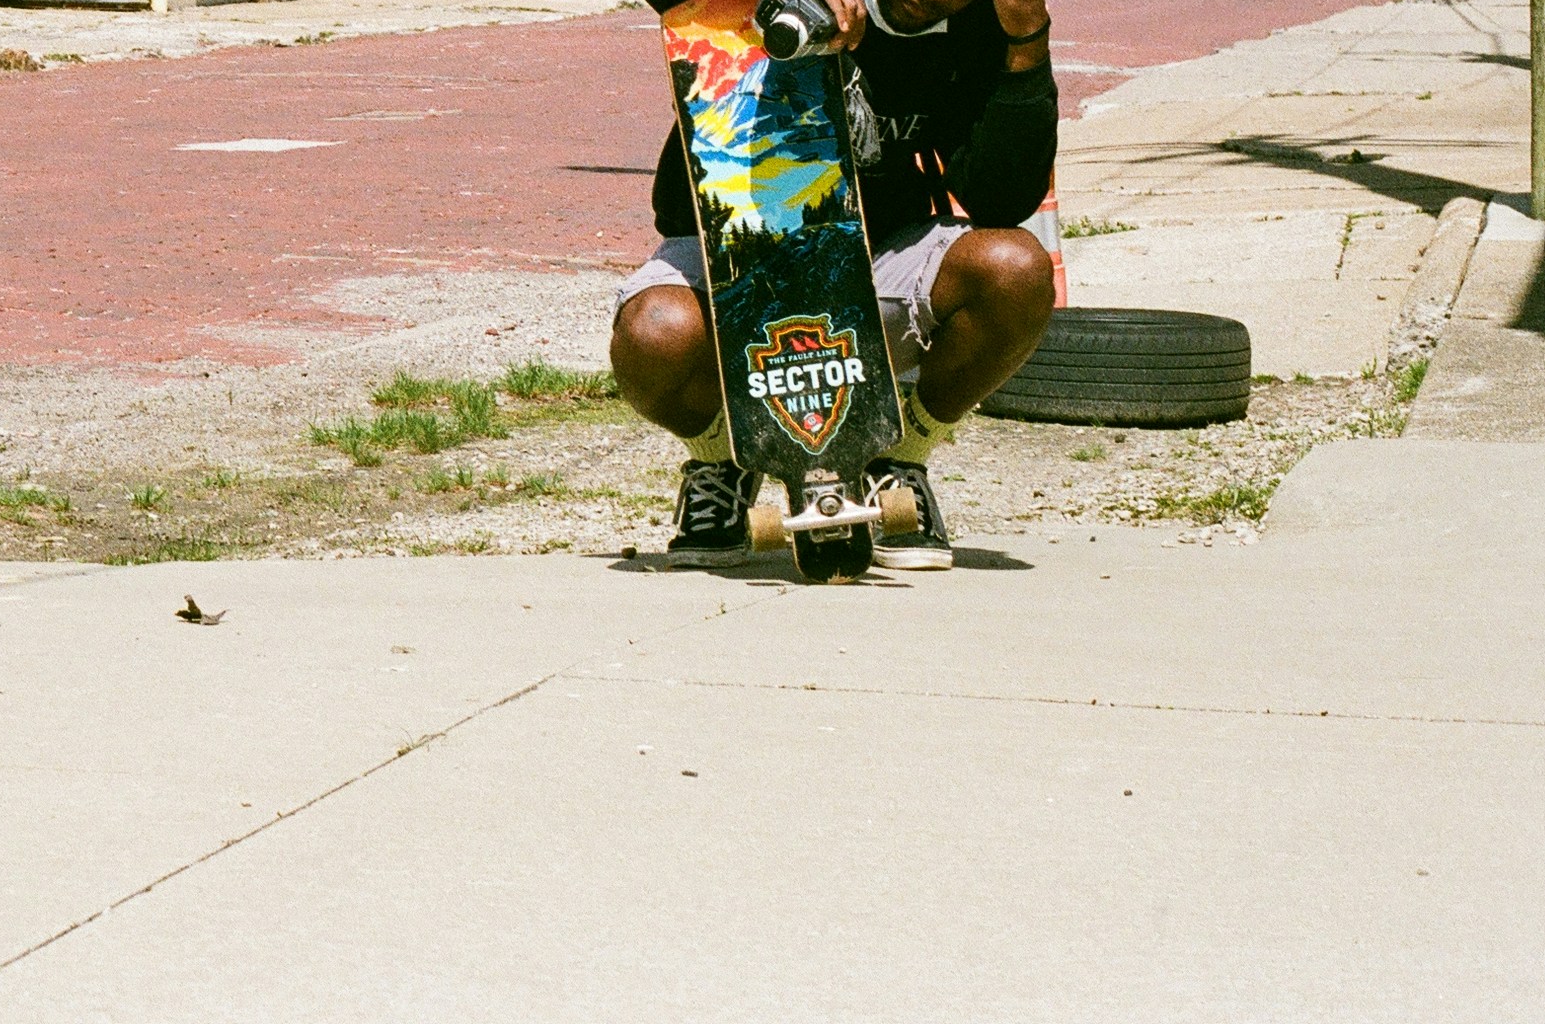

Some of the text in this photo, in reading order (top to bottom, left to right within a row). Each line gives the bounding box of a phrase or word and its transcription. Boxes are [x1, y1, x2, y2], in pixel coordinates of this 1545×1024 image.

[768, 348, 837, 365] THE FAULT LINE
[747, 358, 867, 398] SECTOR
[786, 392, 833, 413] NINE
